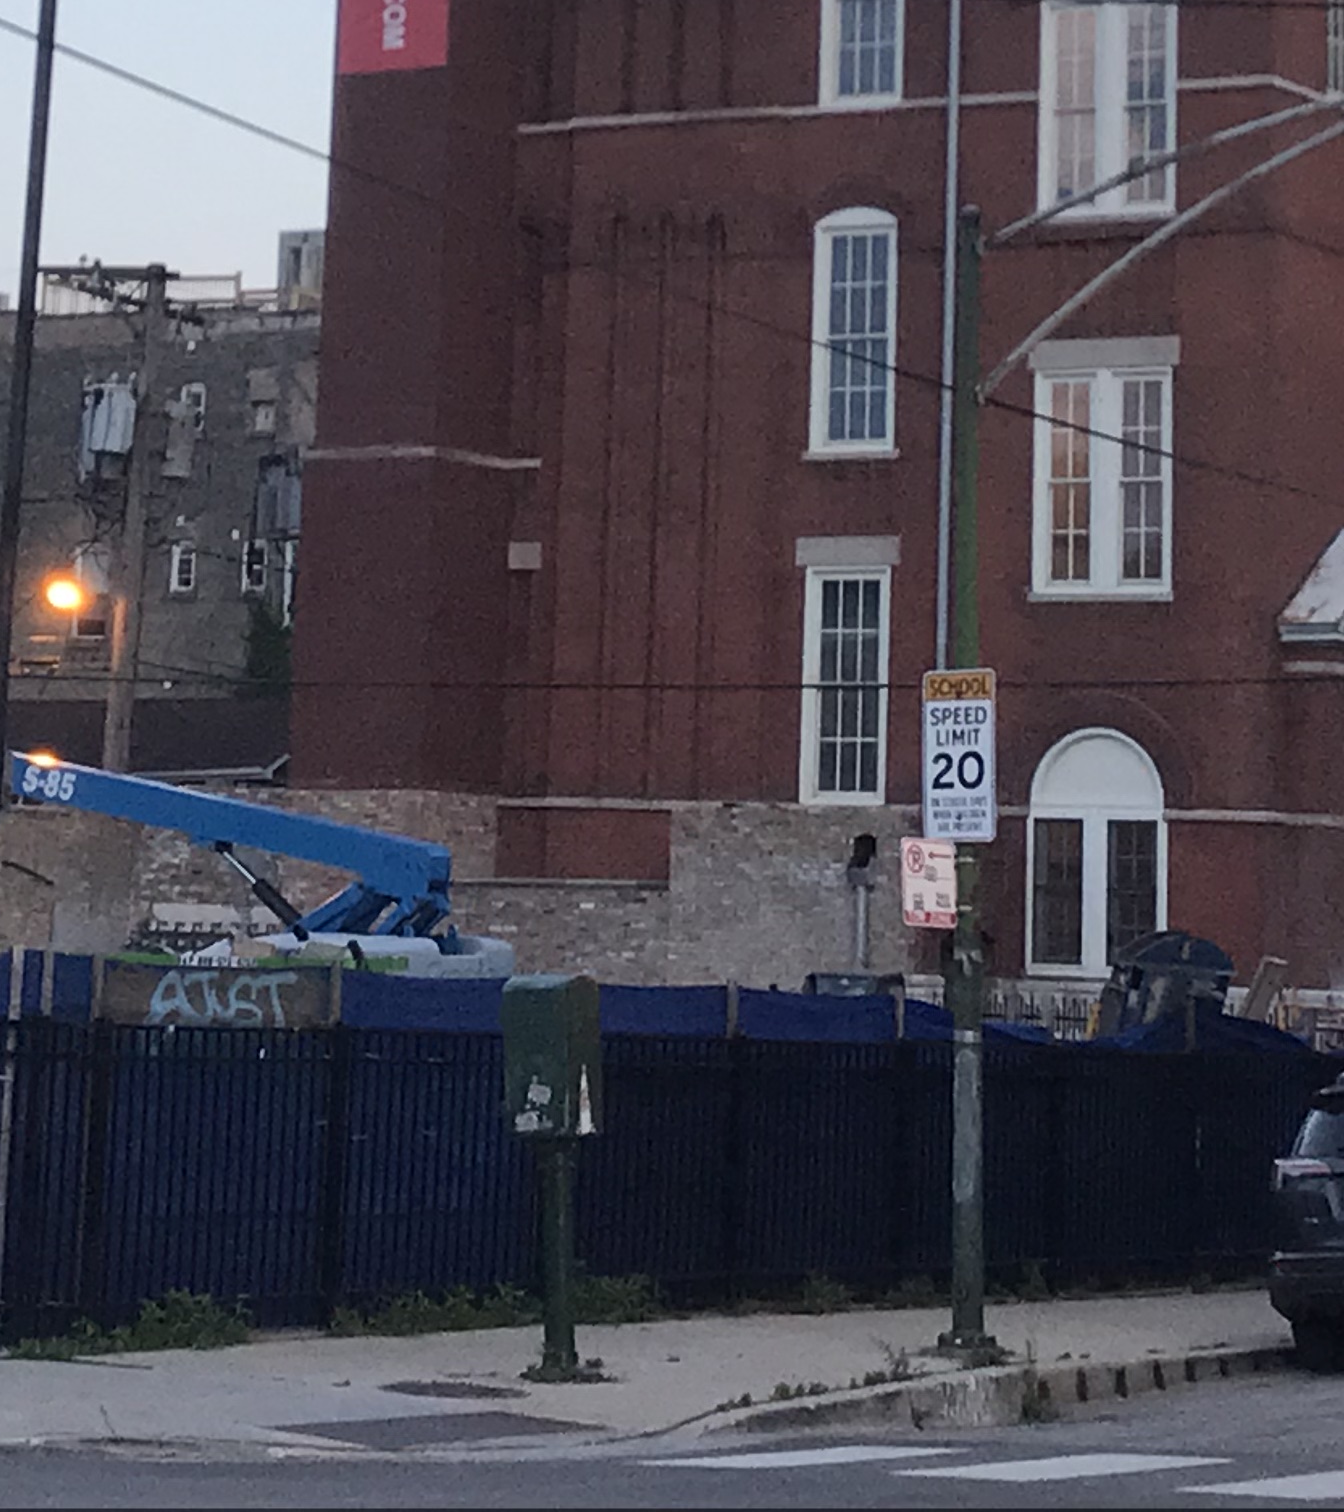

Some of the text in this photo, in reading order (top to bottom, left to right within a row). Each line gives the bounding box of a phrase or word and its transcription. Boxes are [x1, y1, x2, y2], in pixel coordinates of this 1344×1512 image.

[929, 675, 989, 696] SCHOOL
[930, 706, 988, 727] SPEED
[935, 728, 981, 747] LIMIT
[931, 751, 985, 790] 20
[22, 764, 77, 801] S-85
